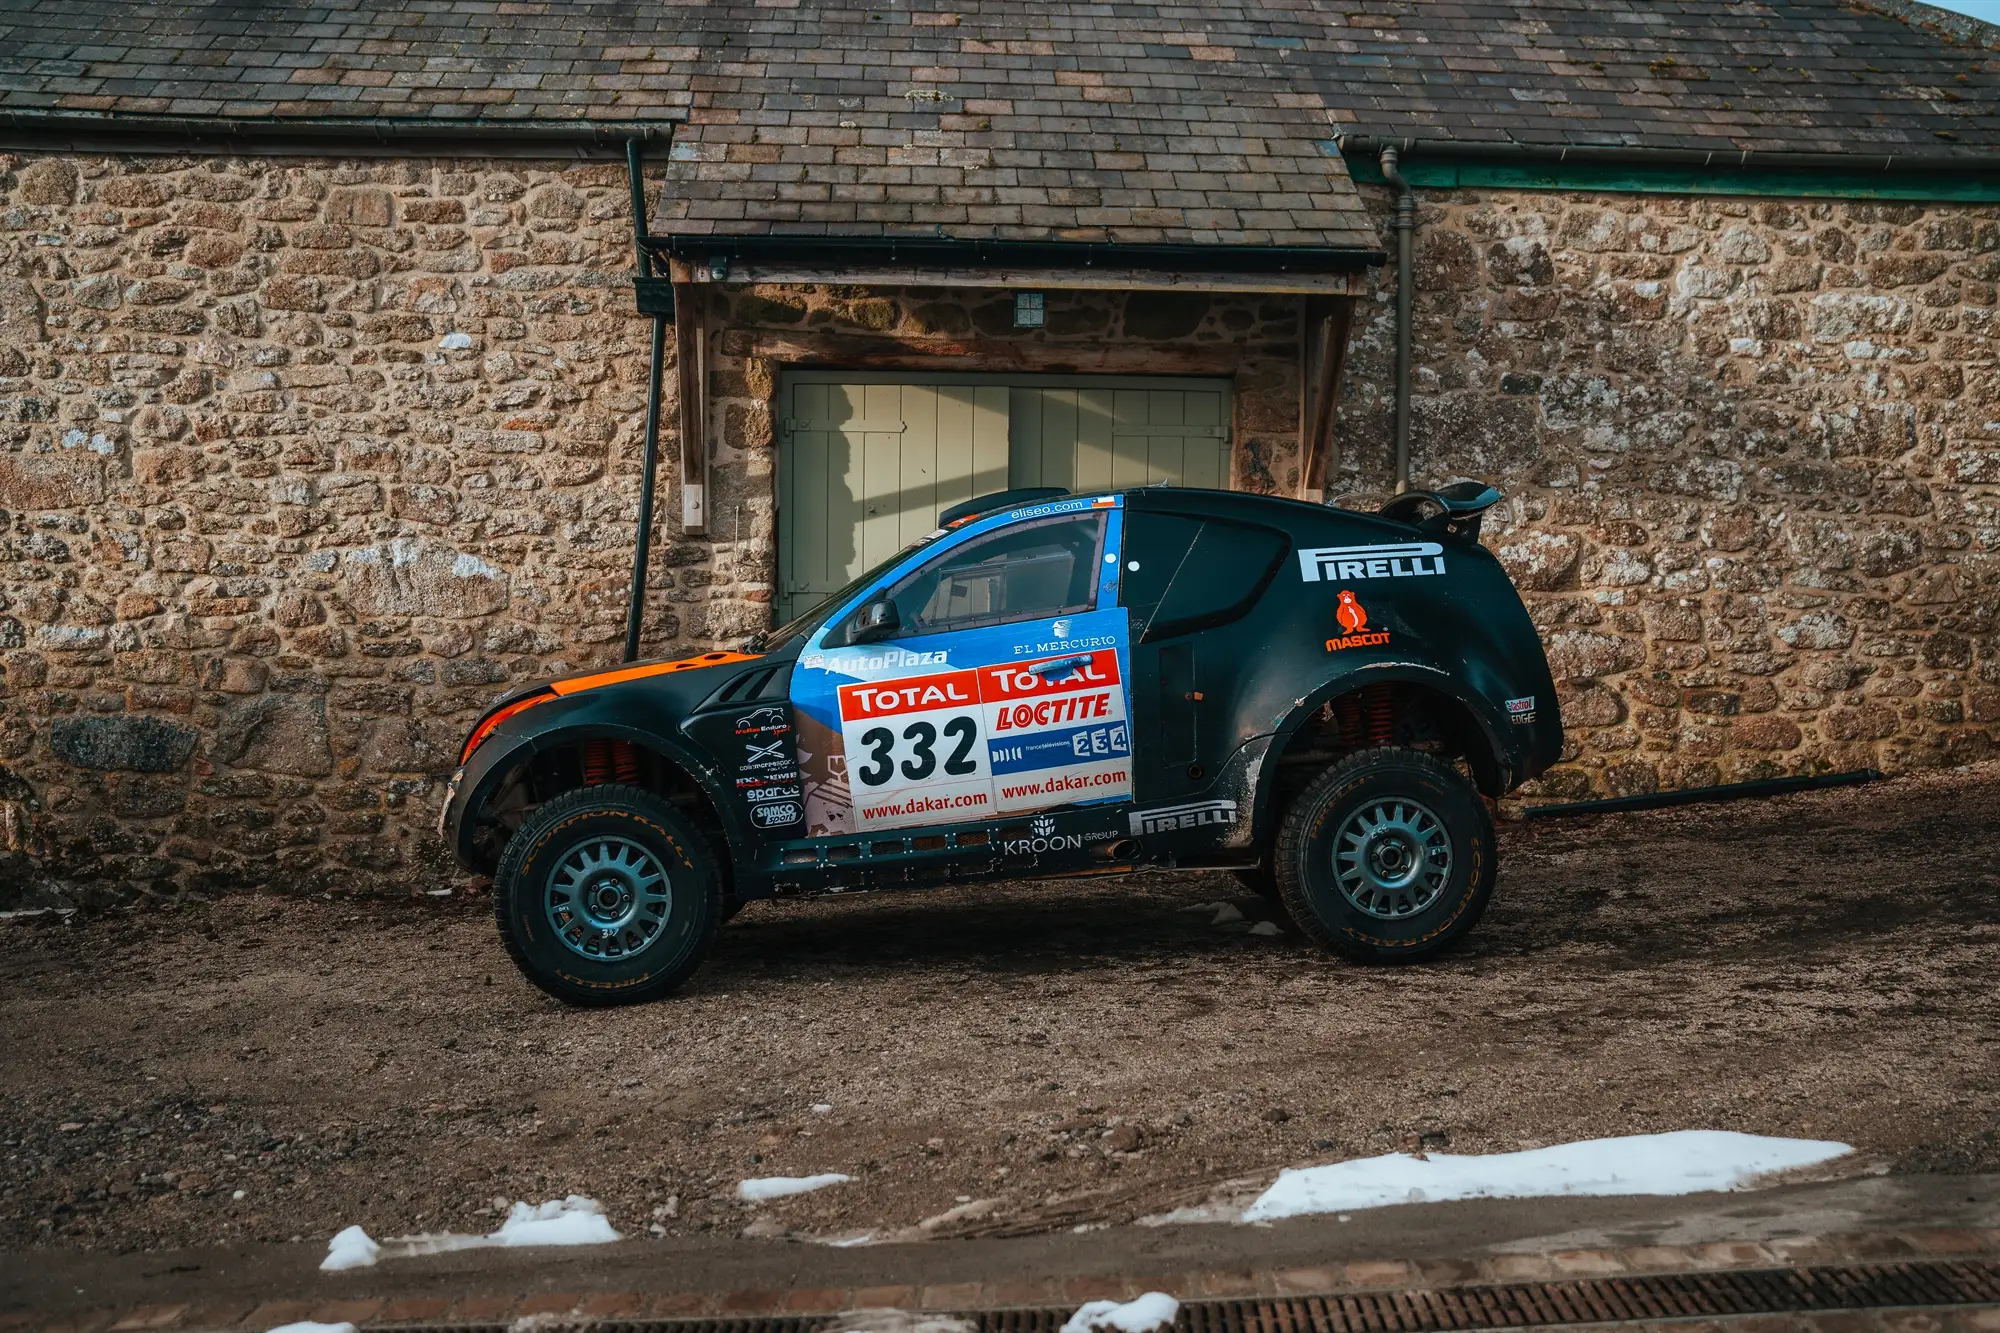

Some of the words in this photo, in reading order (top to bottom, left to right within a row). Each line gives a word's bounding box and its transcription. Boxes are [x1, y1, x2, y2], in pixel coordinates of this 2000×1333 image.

[1011, 501, 1083, 519] eliseo.com
[1297, 542, 1446, 582] PIRELLI
[1014, 644, 1034, 655] EL
[1036, 635, 1116, 653] MERCURIO
[1325, 632, 1390, 652] MASCOT
[824, 650, 949, 675] AutoPlaza
[991, 661, 1106, 693] TOAL
[852, 683, 969, 713] TOTAL
[996, 693, 1111, 731] LOCTITE
[1511, 712, 1536, 724] EDGE
[859, 715, 977, 787] 332
[1077, 738, 1090, 754] 2
[1095, 736, 1108, 751] 3
[1113, 732, 1126, 748] 4
[1001, 770, 1127, 799] www.dakar.com
[756, 804, 795, 818] SAMCO
[768, 812, 794, 824] sport
[862, 792, 988, 820] www.dakar.com
[1128, 800, 1238, 837] PIRELLI
[1003, 834, 1082, 856] KROON
[1084, 830, 1119, 841] GROUP
